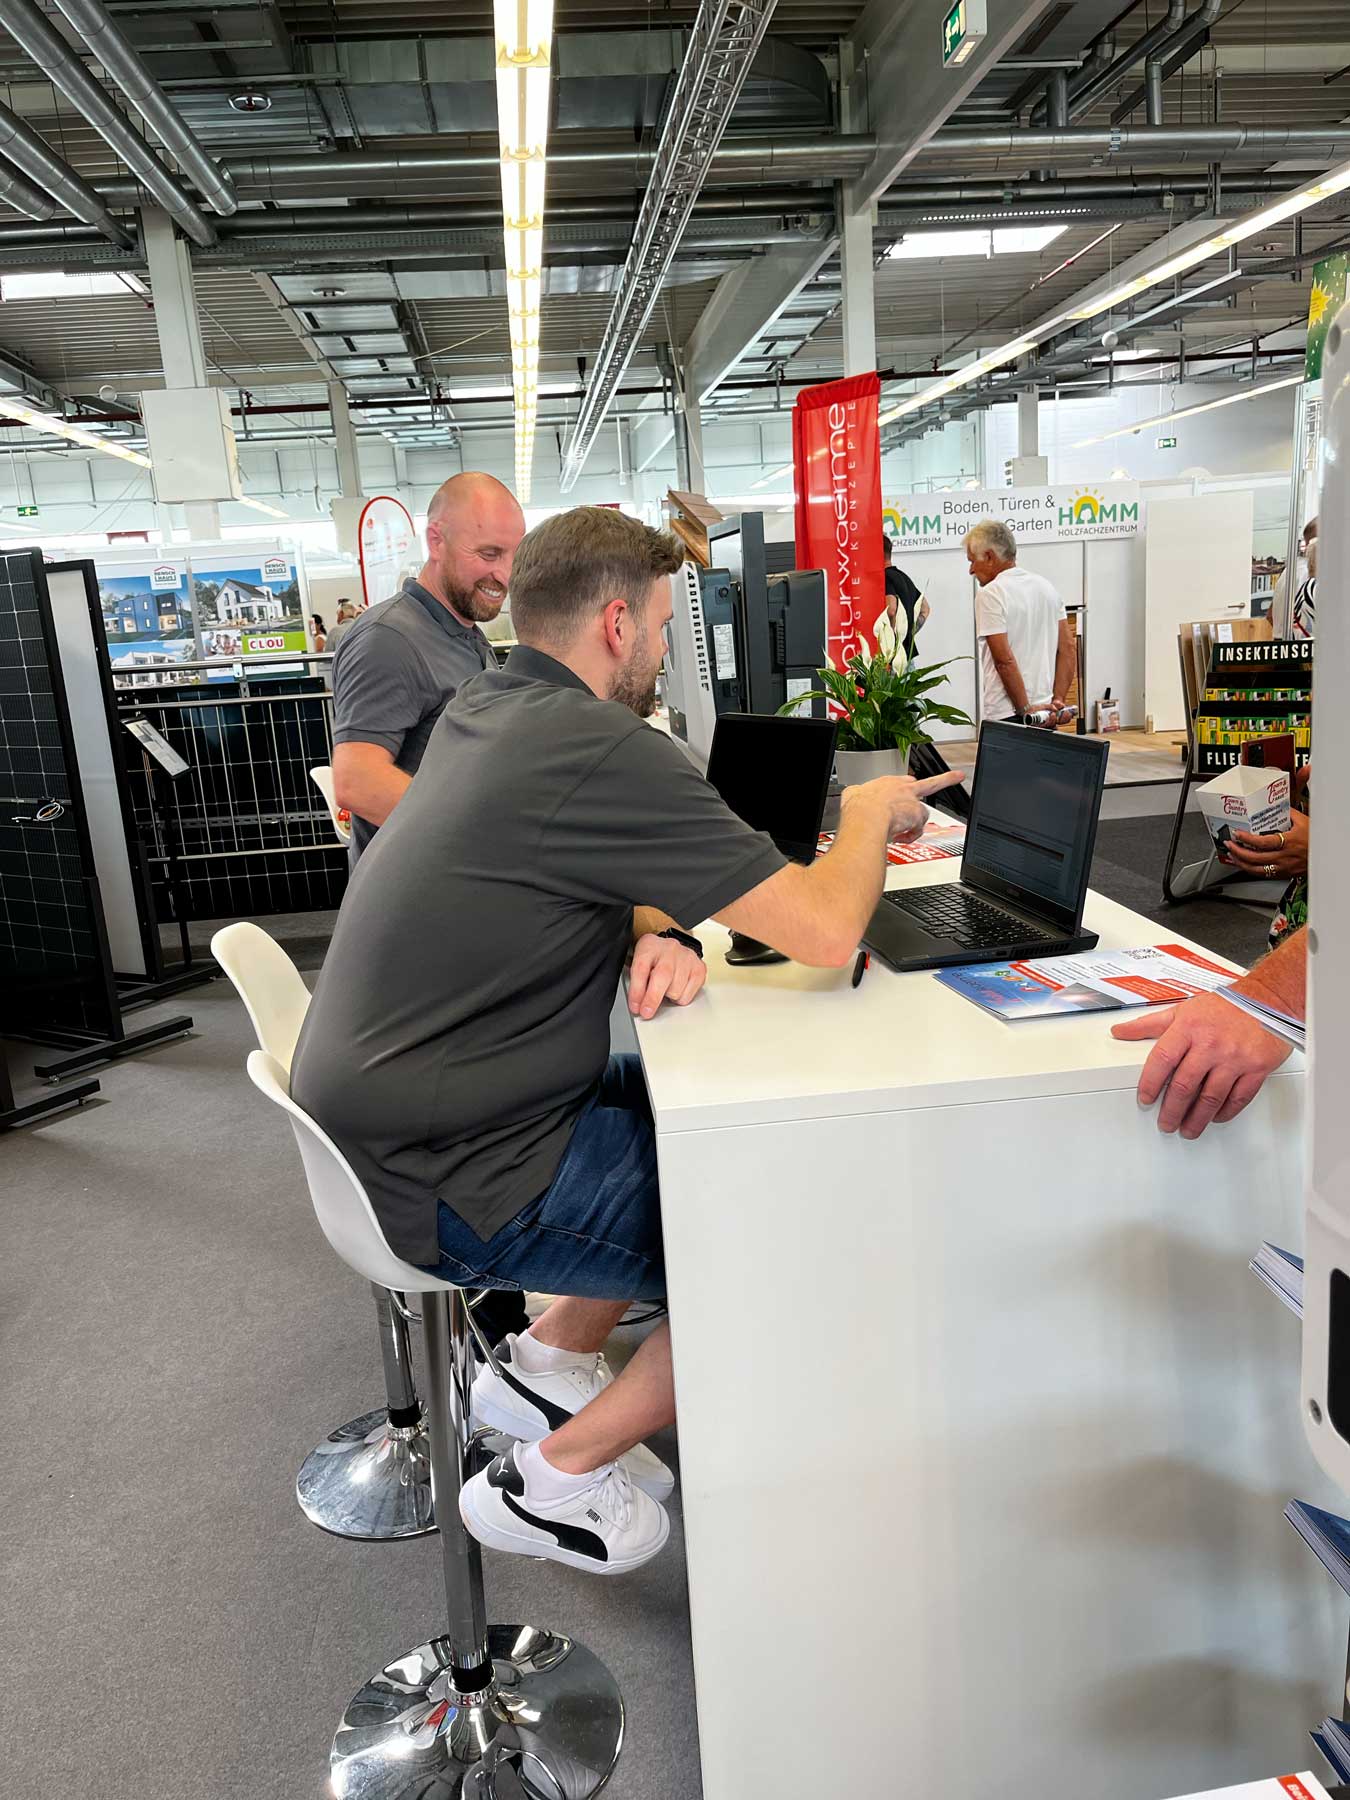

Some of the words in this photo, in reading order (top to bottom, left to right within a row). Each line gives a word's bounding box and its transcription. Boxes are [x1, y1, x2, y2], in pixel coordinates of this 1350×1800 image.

[943, 500, 993, 515] Boden,
[998, 497, 1040, 511] Türen
[1045, 494, 1055, 508] &
[1058, 503, 1138, 525] HAMM
[883, 515, 941, 536] AMM
[946, 521, 976, 536] Hol
[1004, 518, 1052, 532] Garten
[1058, 525, 1138, 537] HOLZFACHZENTRUM
[828, 403, 856, 675] aturwaerme
[892, 537, 941, 548] CHZENTRUM
[249, 638, 284, 649] CLOU
